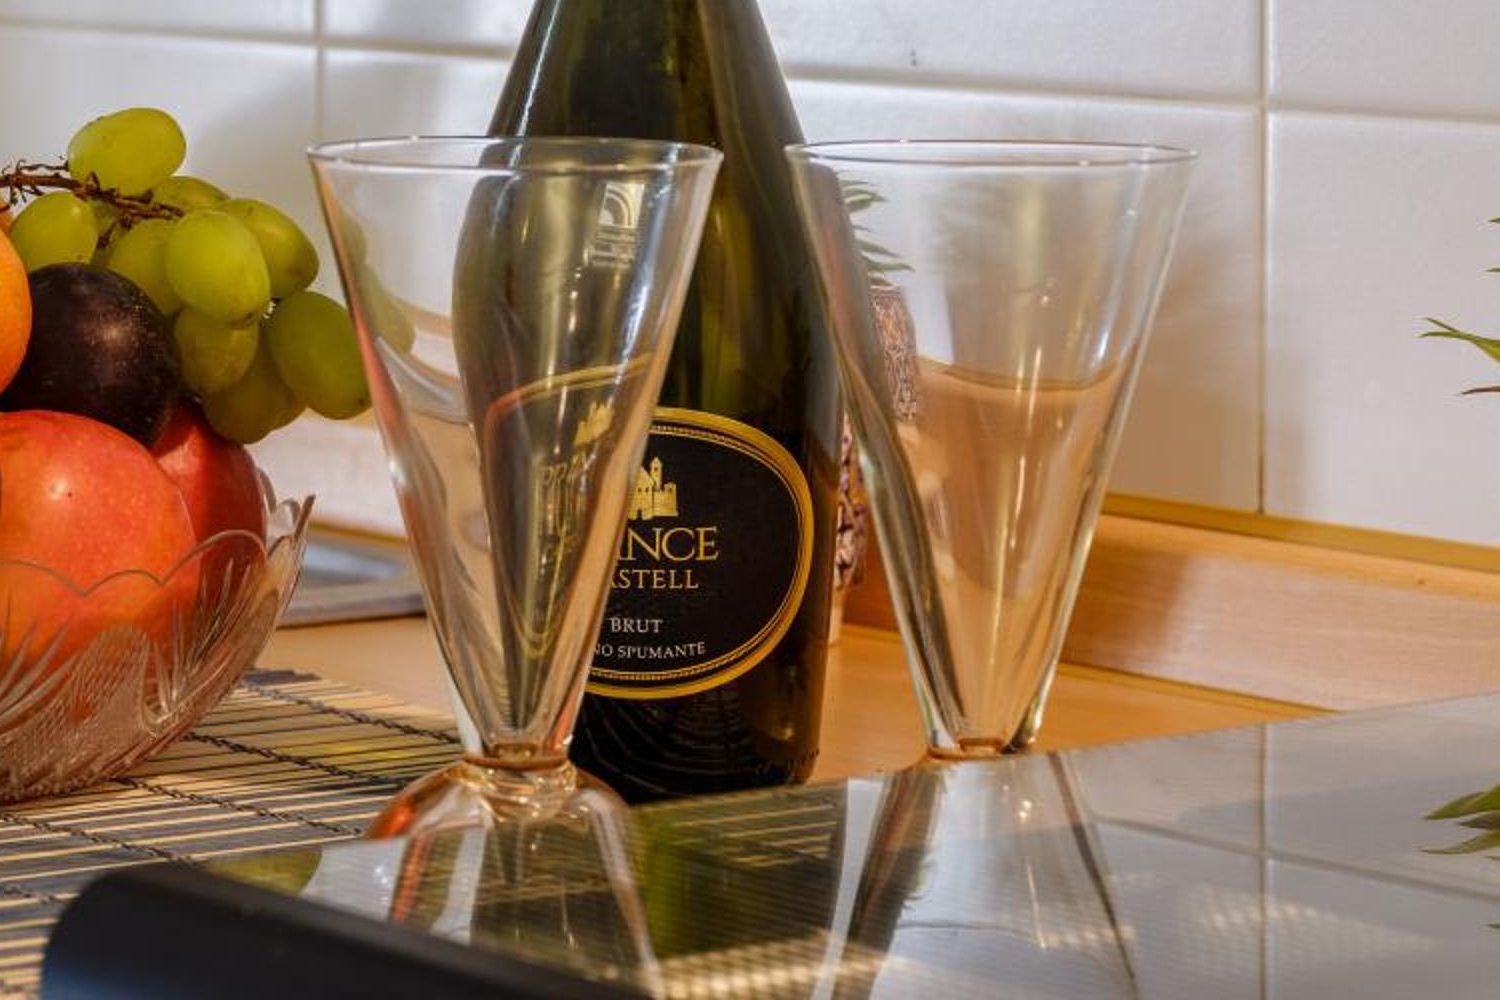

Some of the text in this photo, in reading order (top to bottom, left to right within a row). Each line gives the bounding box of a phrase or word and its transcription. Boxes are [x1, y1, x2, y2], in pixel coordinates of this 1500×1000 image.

[619, 526, 719, 561] NCE
[609, 617, 663, 633] BRUT
[618, 641, 705, 658] SPUMANTE
